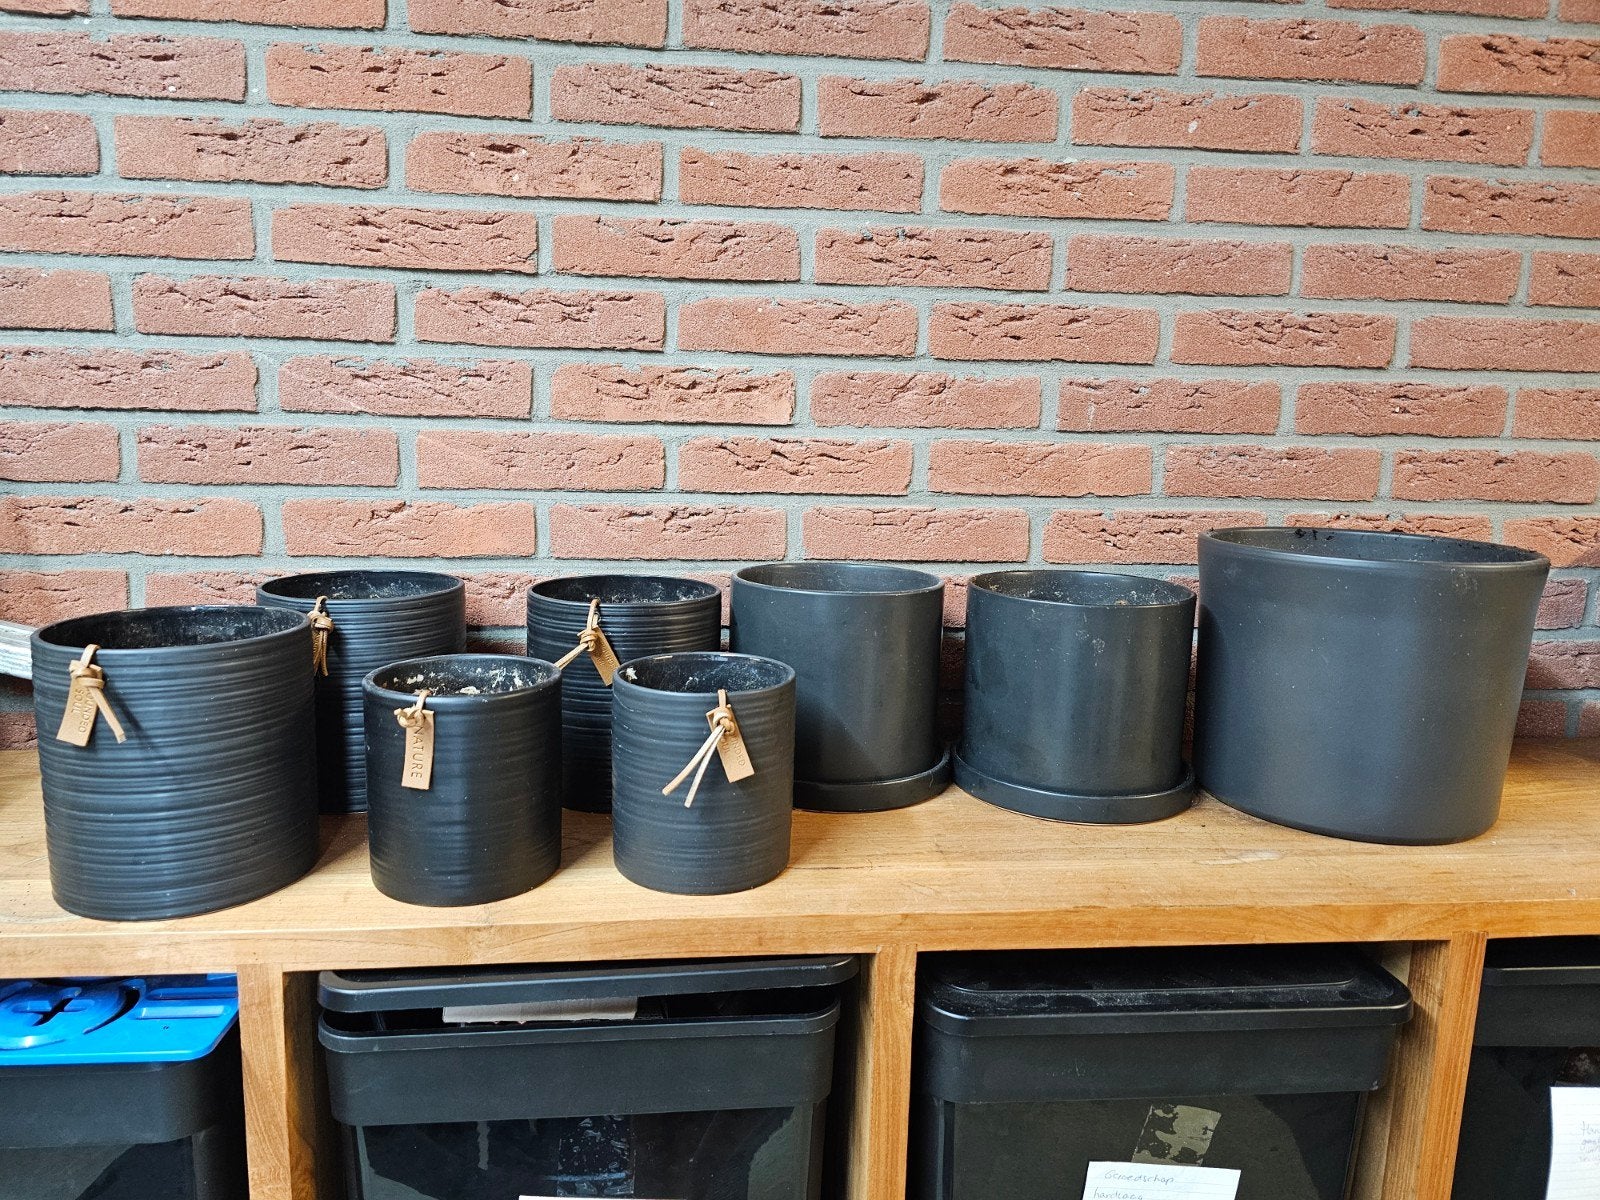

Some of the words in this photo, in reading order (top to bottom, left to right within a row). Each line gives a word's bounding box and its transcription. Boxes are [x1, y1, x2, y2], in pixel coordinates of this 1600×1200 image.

[71, 687, 85, 715] SOUL
[79, 688, 95, 733] OUNDED
[410, 724, 424, 779] NATURE
